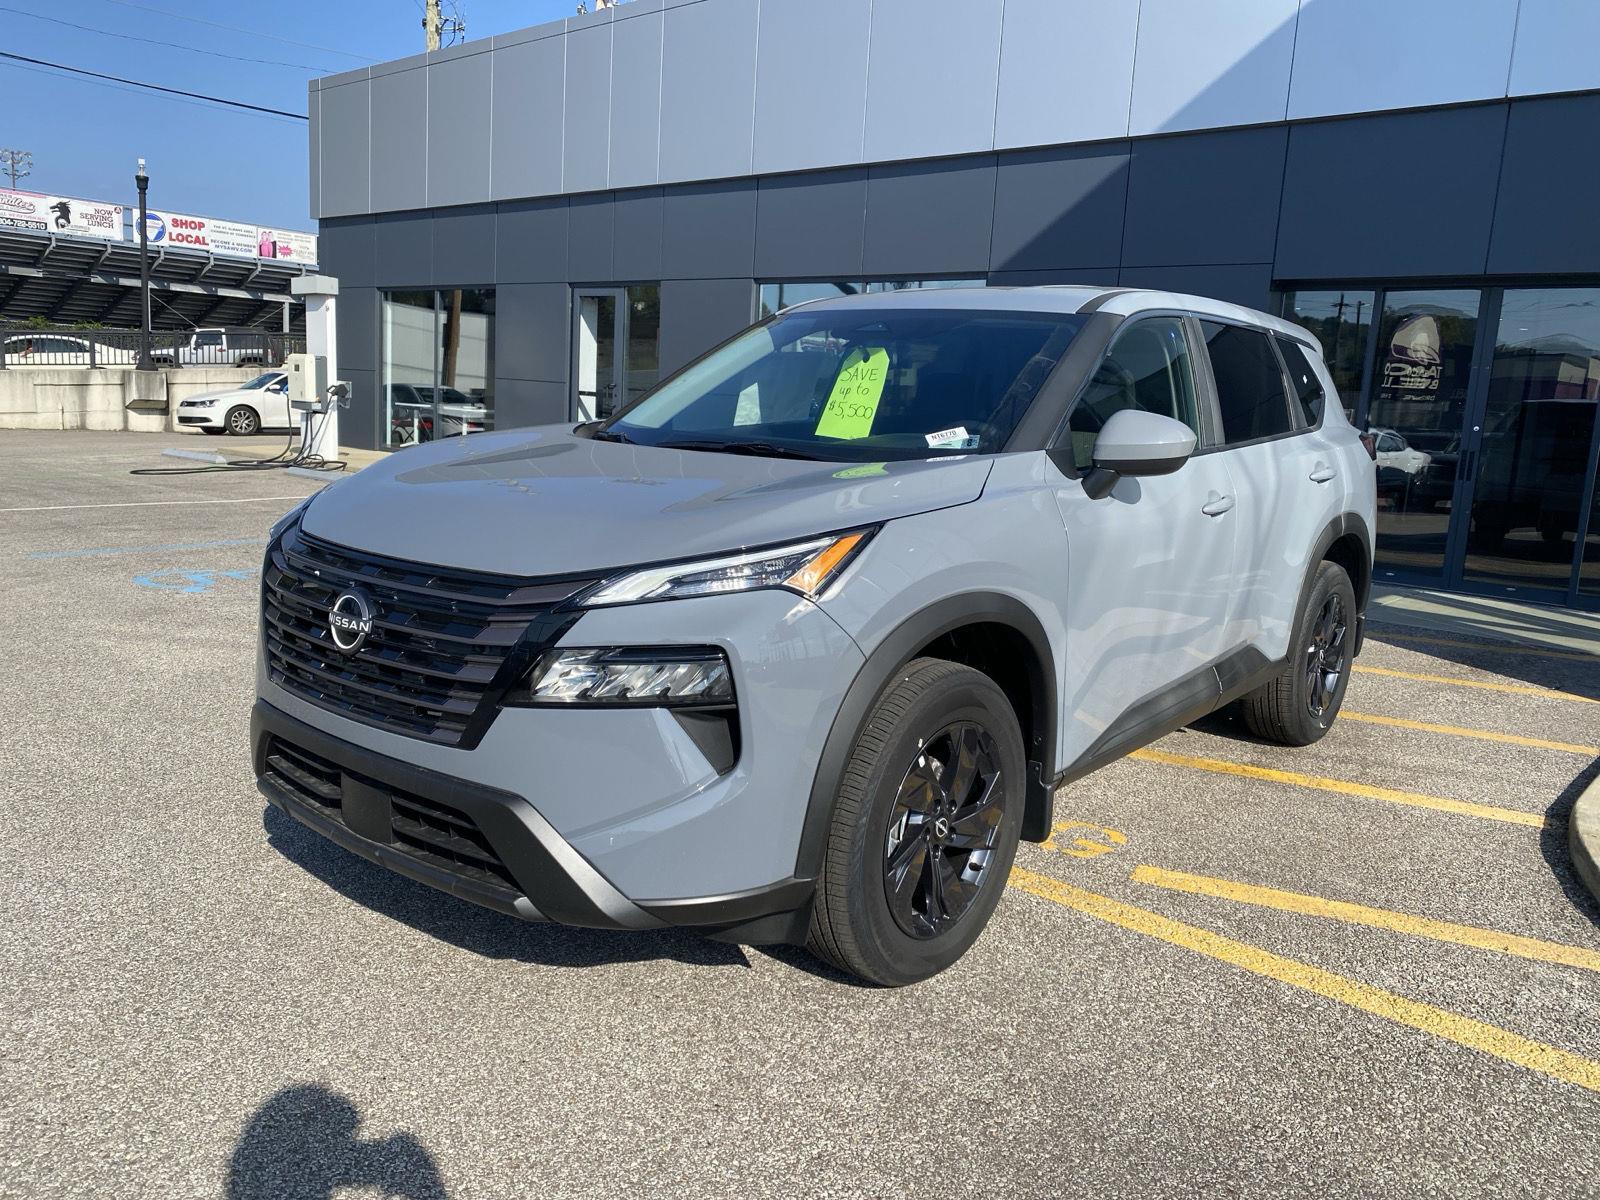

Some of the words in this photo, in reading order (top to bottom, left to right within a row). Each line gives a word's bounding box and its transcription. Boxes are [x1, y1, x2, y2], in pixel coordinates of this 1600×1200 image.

[80, 212, 114, 223] SERVING
[94, 208, 114, 216] NOW
[87, 219, 114, 229] LUNCH
[171, 217, 206, 231] SHOP
[168, 232, 210, 246] LOCAL
[840, 367, 879, 382] SAVE
[839, 386, 851, 400] up
[856, 383, 870, 396] to
[828, 400, 874, 420] $5,500
[328, 612, 371, 633] NISSAN
